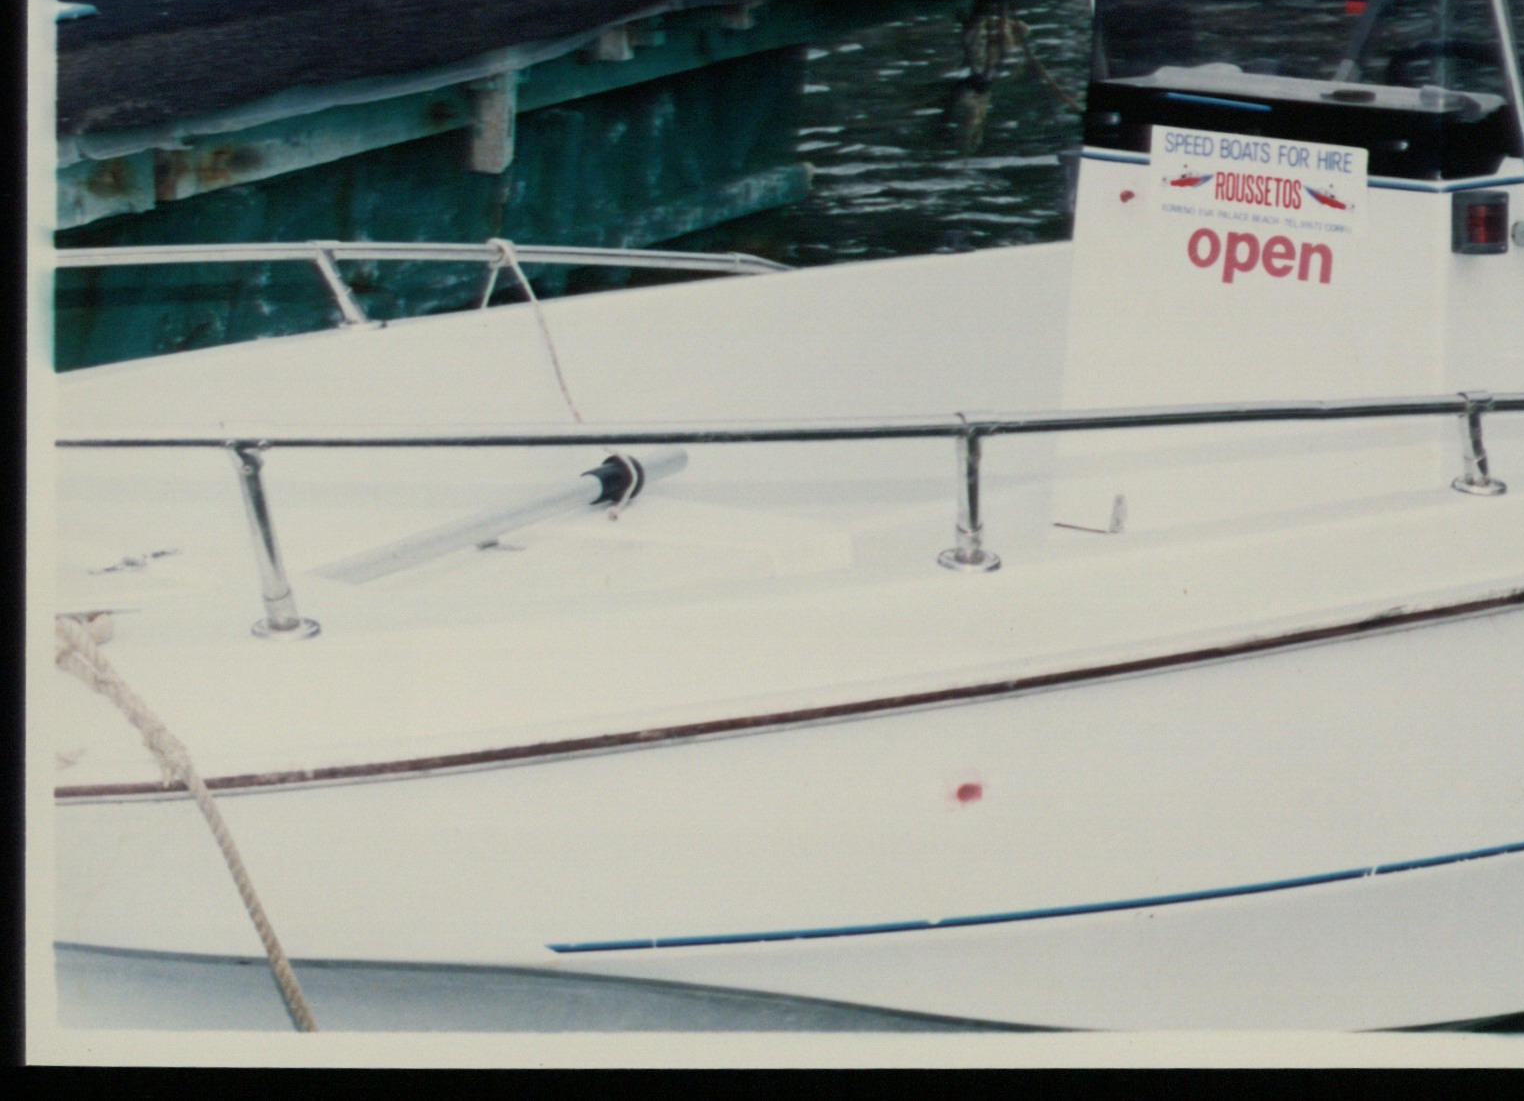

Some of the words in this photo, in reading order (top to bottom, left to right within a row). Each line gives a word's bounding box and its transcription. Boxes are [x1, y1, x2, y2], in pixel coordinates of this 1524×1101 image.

[1164, 131, 1215, 158] SPEED
[1220, 138, 1271, 165] BOATS
[1278, 145, 1310, 169] FOR
[1316, 150, 1353, 174] HIRE
[1214, 171, 1303, 210] ROUSSETOS
[1187, 227, 1333, 285] open
